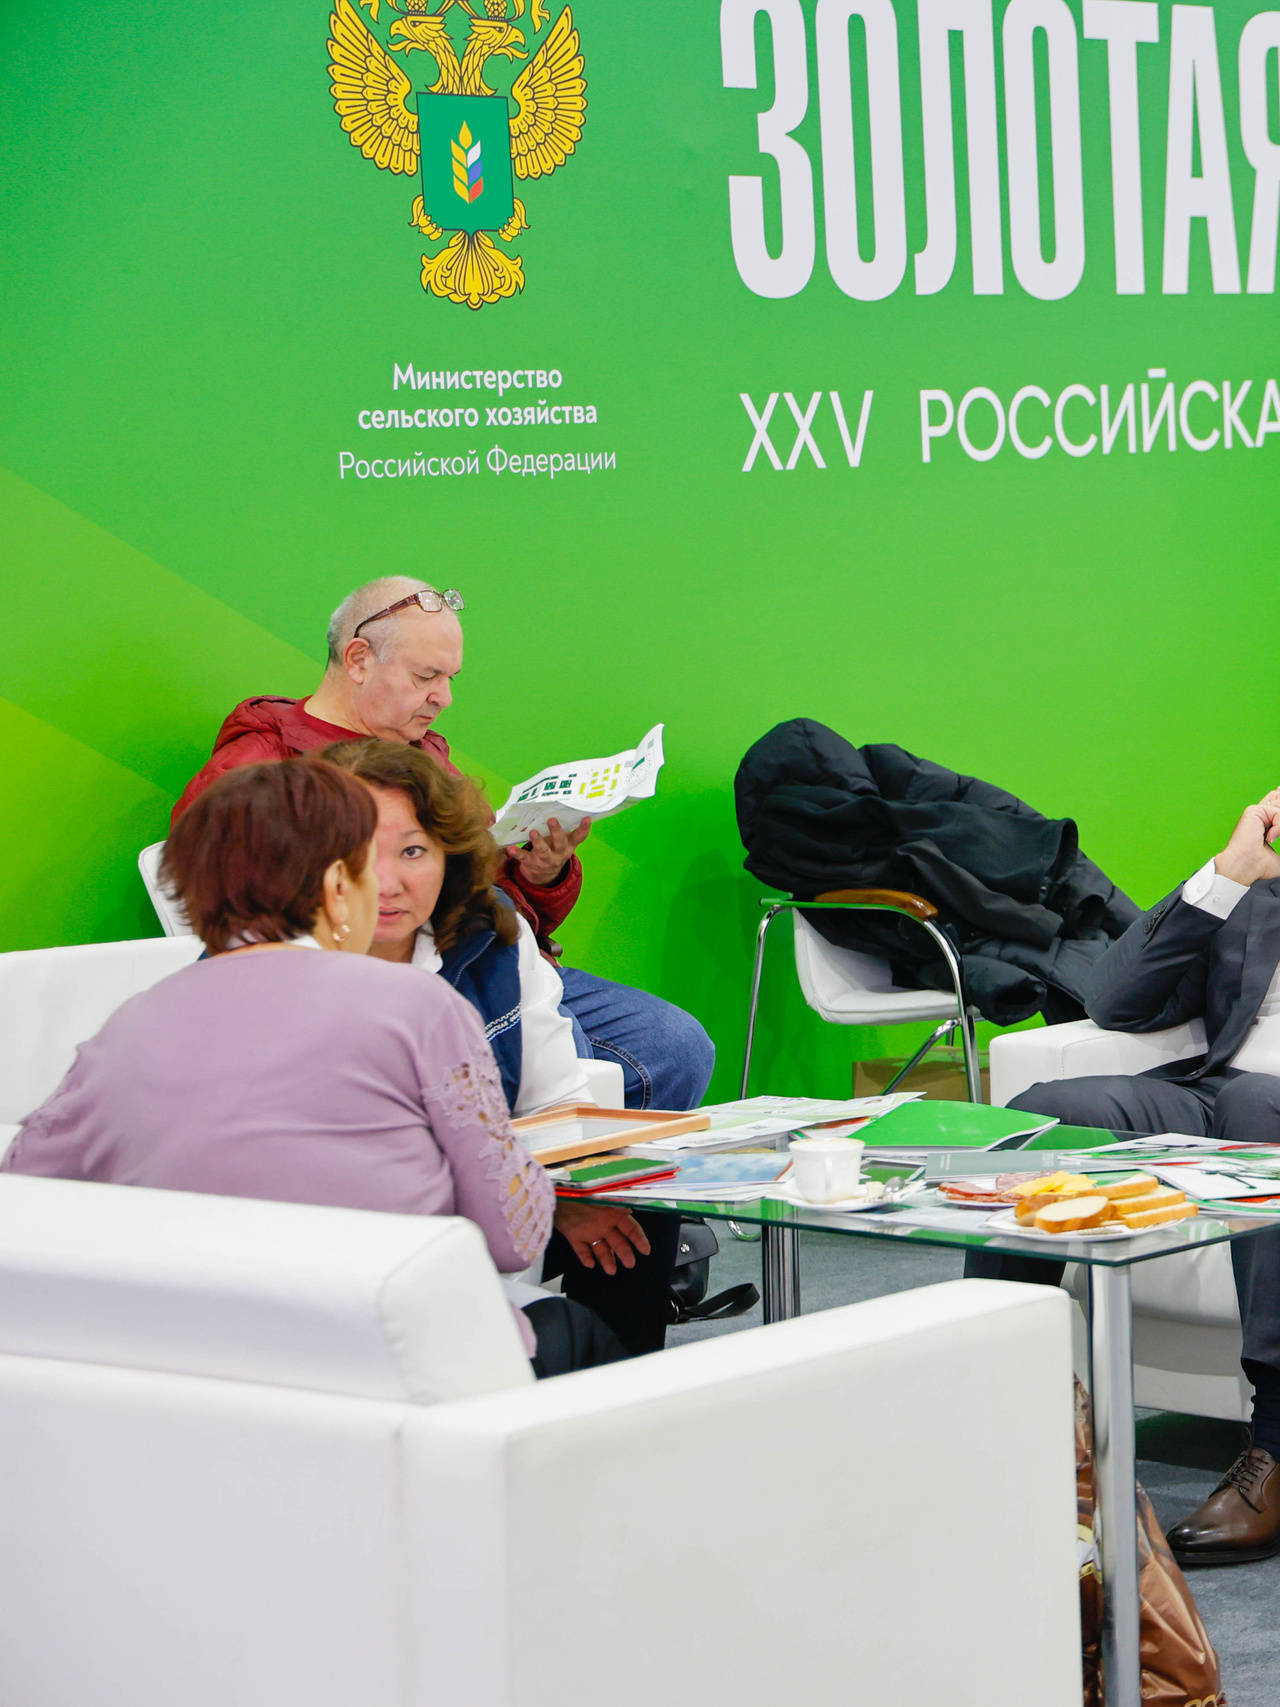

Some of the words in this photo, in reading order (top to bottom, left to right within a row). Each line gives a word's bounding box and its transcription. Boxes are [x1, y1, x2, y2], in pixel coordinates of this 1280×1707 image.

[392, 362, 563, 397] Министерство
[358, 407, 480, 430] сельского
[485, 399, 598, 427] хозяйства
[740, 390, 874, 471] XXV
[339, 450, 480, 480] Российской
[486, 444, 617, 480] Федерации
